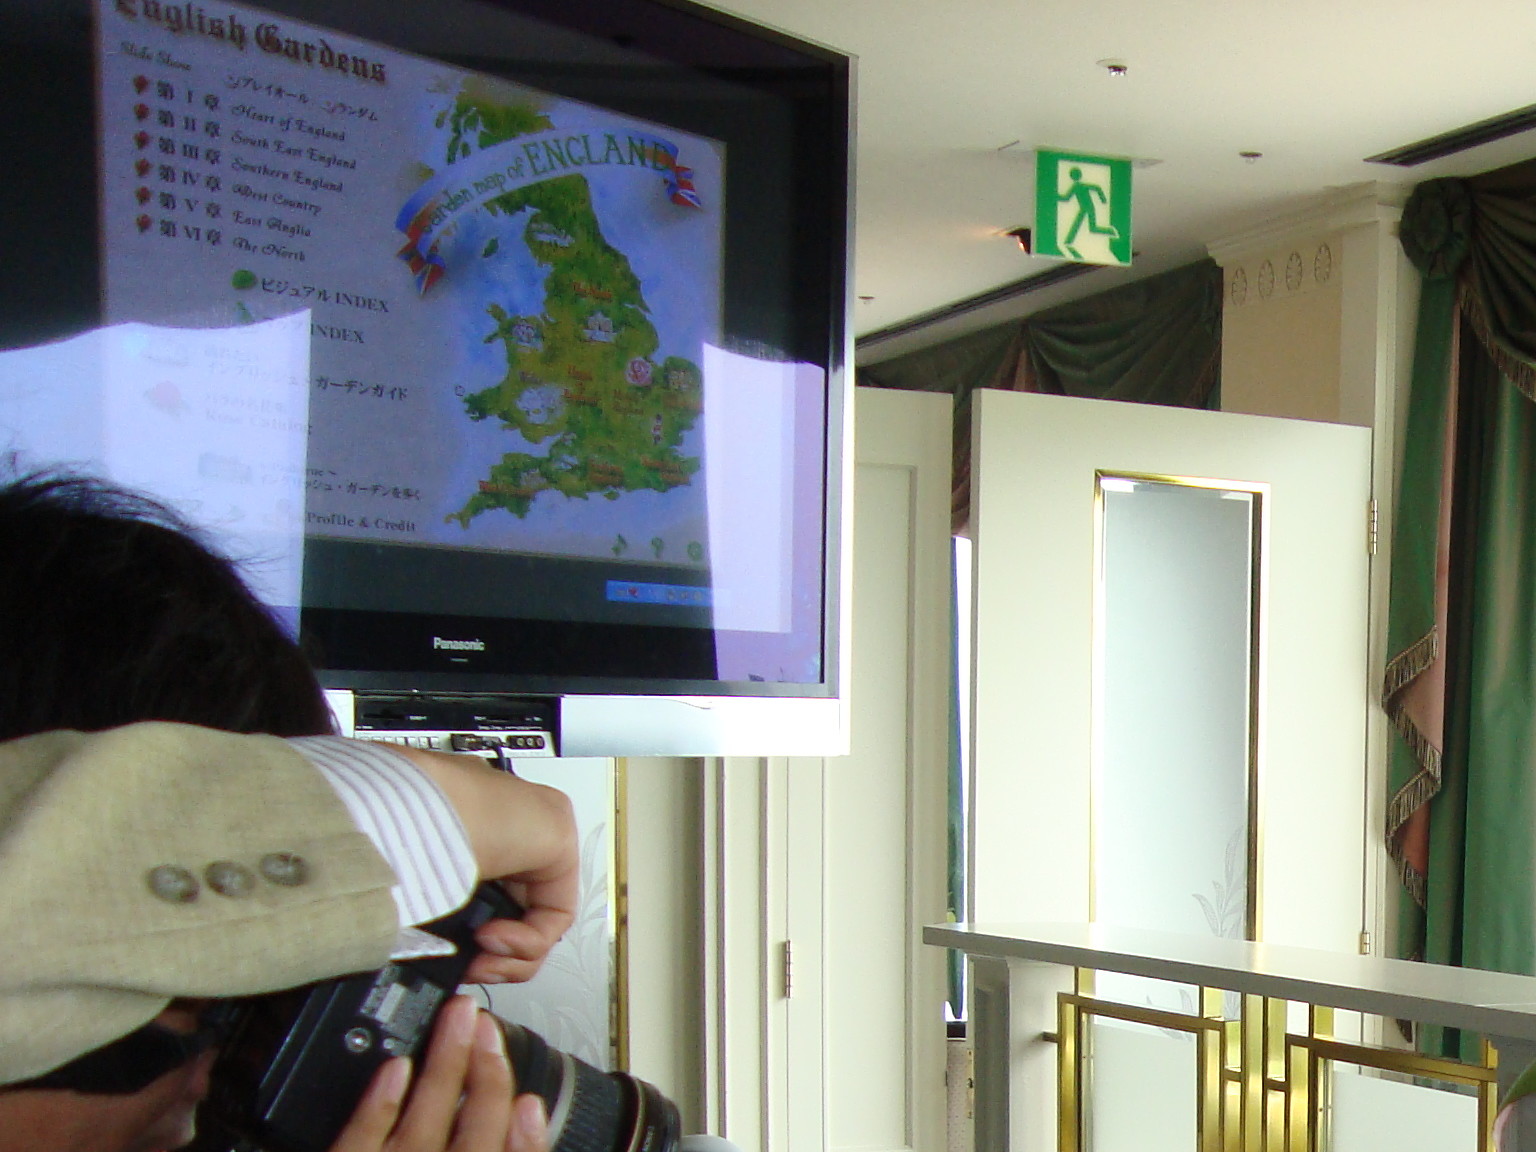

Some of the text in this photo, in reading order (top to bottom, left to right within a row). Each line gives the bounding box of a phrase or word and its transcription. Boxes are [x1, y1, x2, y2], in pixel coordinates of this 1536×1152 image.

[254, 22, 387, 83] Gardens
[520, 132, 671, 176] ENGLAND
[335, 292, 390, 313] INDEX
[374, 516, 416, 532] Credit
[433, 636, 486, 652] Panasonic
